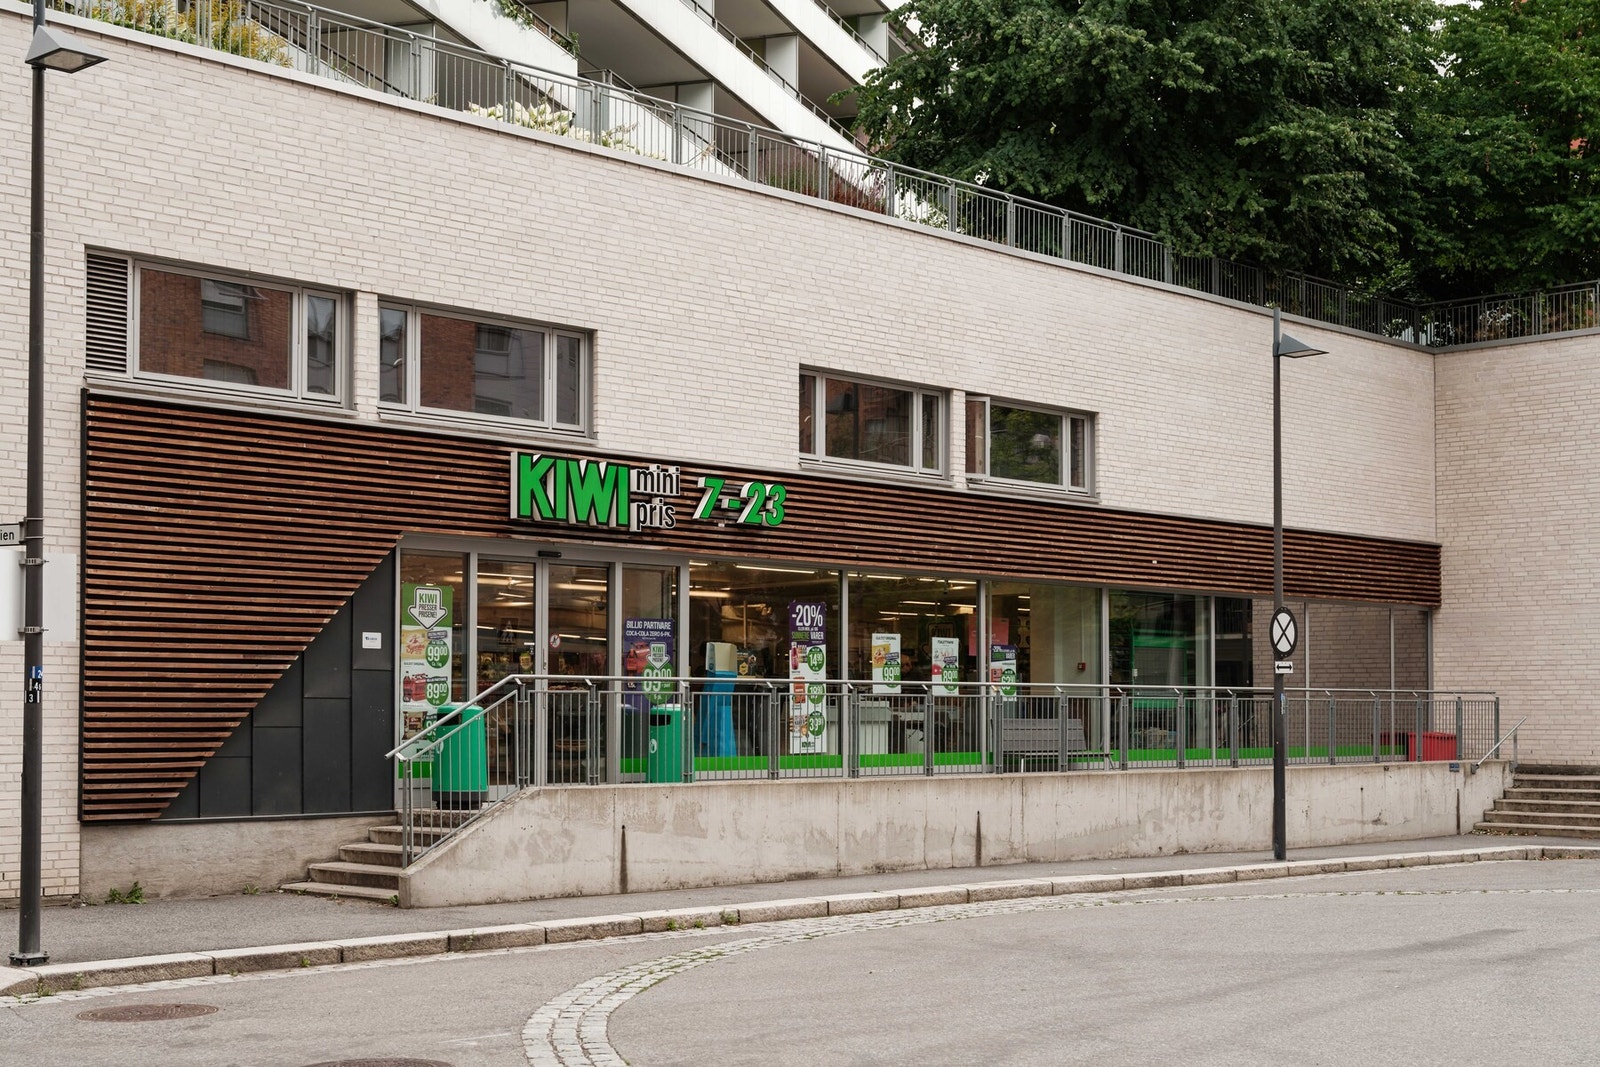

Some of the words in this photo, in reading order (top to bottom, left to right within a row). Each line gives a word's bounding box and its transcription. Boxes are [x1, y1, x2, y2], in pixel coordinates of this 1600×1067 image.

[512, 451, 630, 527] KIWI
[634, 464, 681, 496] mini
[634, 497, 677, 532] pris
[419, 593, 437, 603] KIWI
[626, 620, 642, 629] BILLIG
[643, 621, 671, 629] PARTIVARE
[792, 605, 823, 626] -20%
[29, 694, 33, 702] 3
